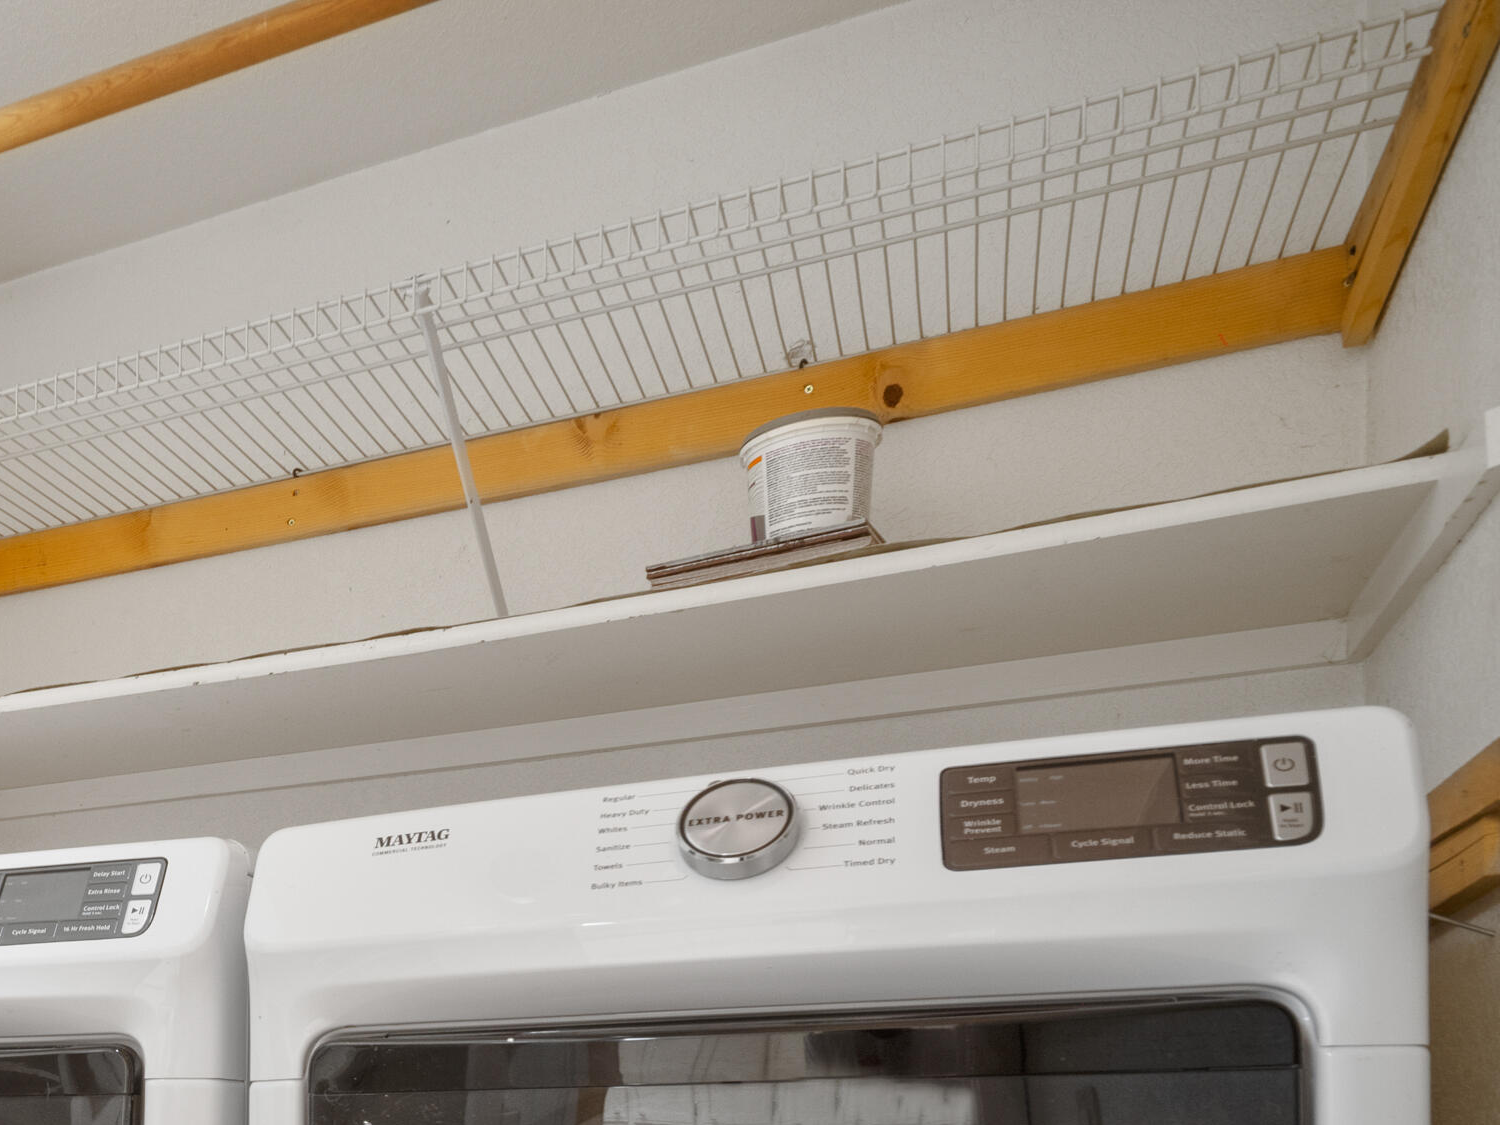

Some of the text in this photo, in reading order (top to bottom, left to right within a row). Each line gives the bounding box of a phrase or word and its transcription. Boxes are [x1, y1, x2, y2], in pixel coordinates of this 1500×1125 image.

[1183, 755, 1239, 766] More Time
[847, 767, 875, 775] Quick
[967, 776, 996, 784] Temp
[1185, 779, 1238, 789] Less Time
[849, 782, 895, 792] Delicates
[603, 794, 635, 803] Regular
[960, 798, 1004, 808] Dryness
[819, 798, 895, 811] Wrinkle Control
[1188, 800, 1256, 812] Control Lock
[688, 809, 784, 826] EXTRA POWER
[822, 817, 895, 830] Steam Refresh
[964, 819, 1001, 827] Wrinkle
[964, 826, 1001, 834] Prevent
[1173, 828, 1247, 840] Reduce Static
[374, 828, 450, 849] MAYTAG
[858, 837, 895, 846] Normal
[1071, 836, 1134, 848] Cycle Signal
[984, 846, 1016, 854] Steam
[594, 863, 623, 871] Towels
[844, 857, 896, 867] Timed Dry
[591, 882, 615, 890] Bulky
